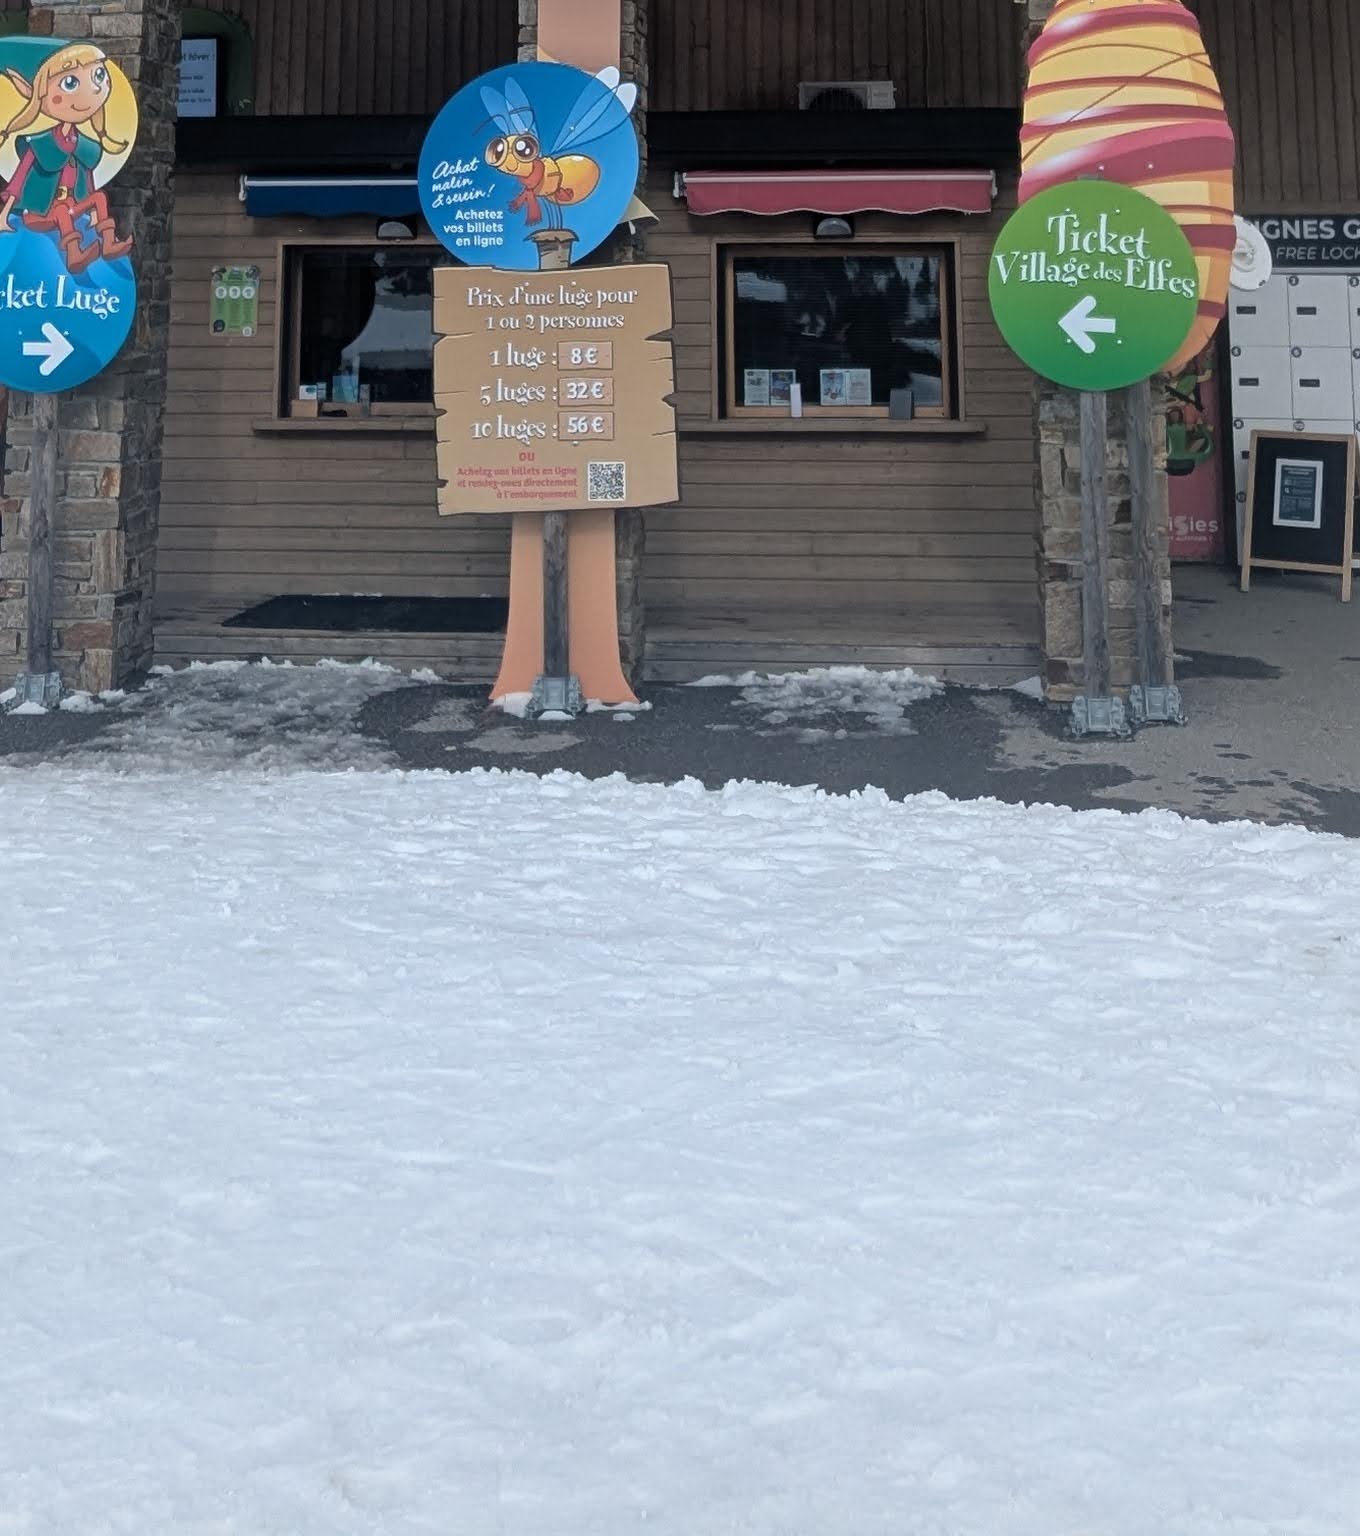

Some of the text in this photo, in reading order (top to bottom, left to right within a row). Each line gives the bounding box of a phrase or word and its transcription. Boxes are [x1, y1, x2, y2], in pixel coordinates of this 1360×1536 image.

[432, 157, 480, 180] Achat
[432, 176, 473, 192] malin
[455, 209, 504, 221] Achetez
[443, 222, 504, 234] vos billets
[1047, 212, 1151, 260] Ticket
[455, 235, 504, 248] en ligne
[1275, 246, 1317, 261] FREE
[995, 250, 1196, 299] Village des Elfes
[56, 274, 121, 320] Luge
[467, 286, 505, 307] Prix
[559, 285, 593, 309] luge
[597, 289, 638, 309] pour
[487, 314, 625, 334] 1 ou 2 personnes
[490, 350, 501, 366] 1
[506, 343, 546, 370] luge
[480, 384, 492, 406] 5
[496, 378, 547, 406] luges
[471, 422, 493, 439] 10
[496, 415, 547, 444] luges
[511, 467, 540, 476] billets
[555, 467, 577, 477] ligne
[524, 478, 578, 487] directement
